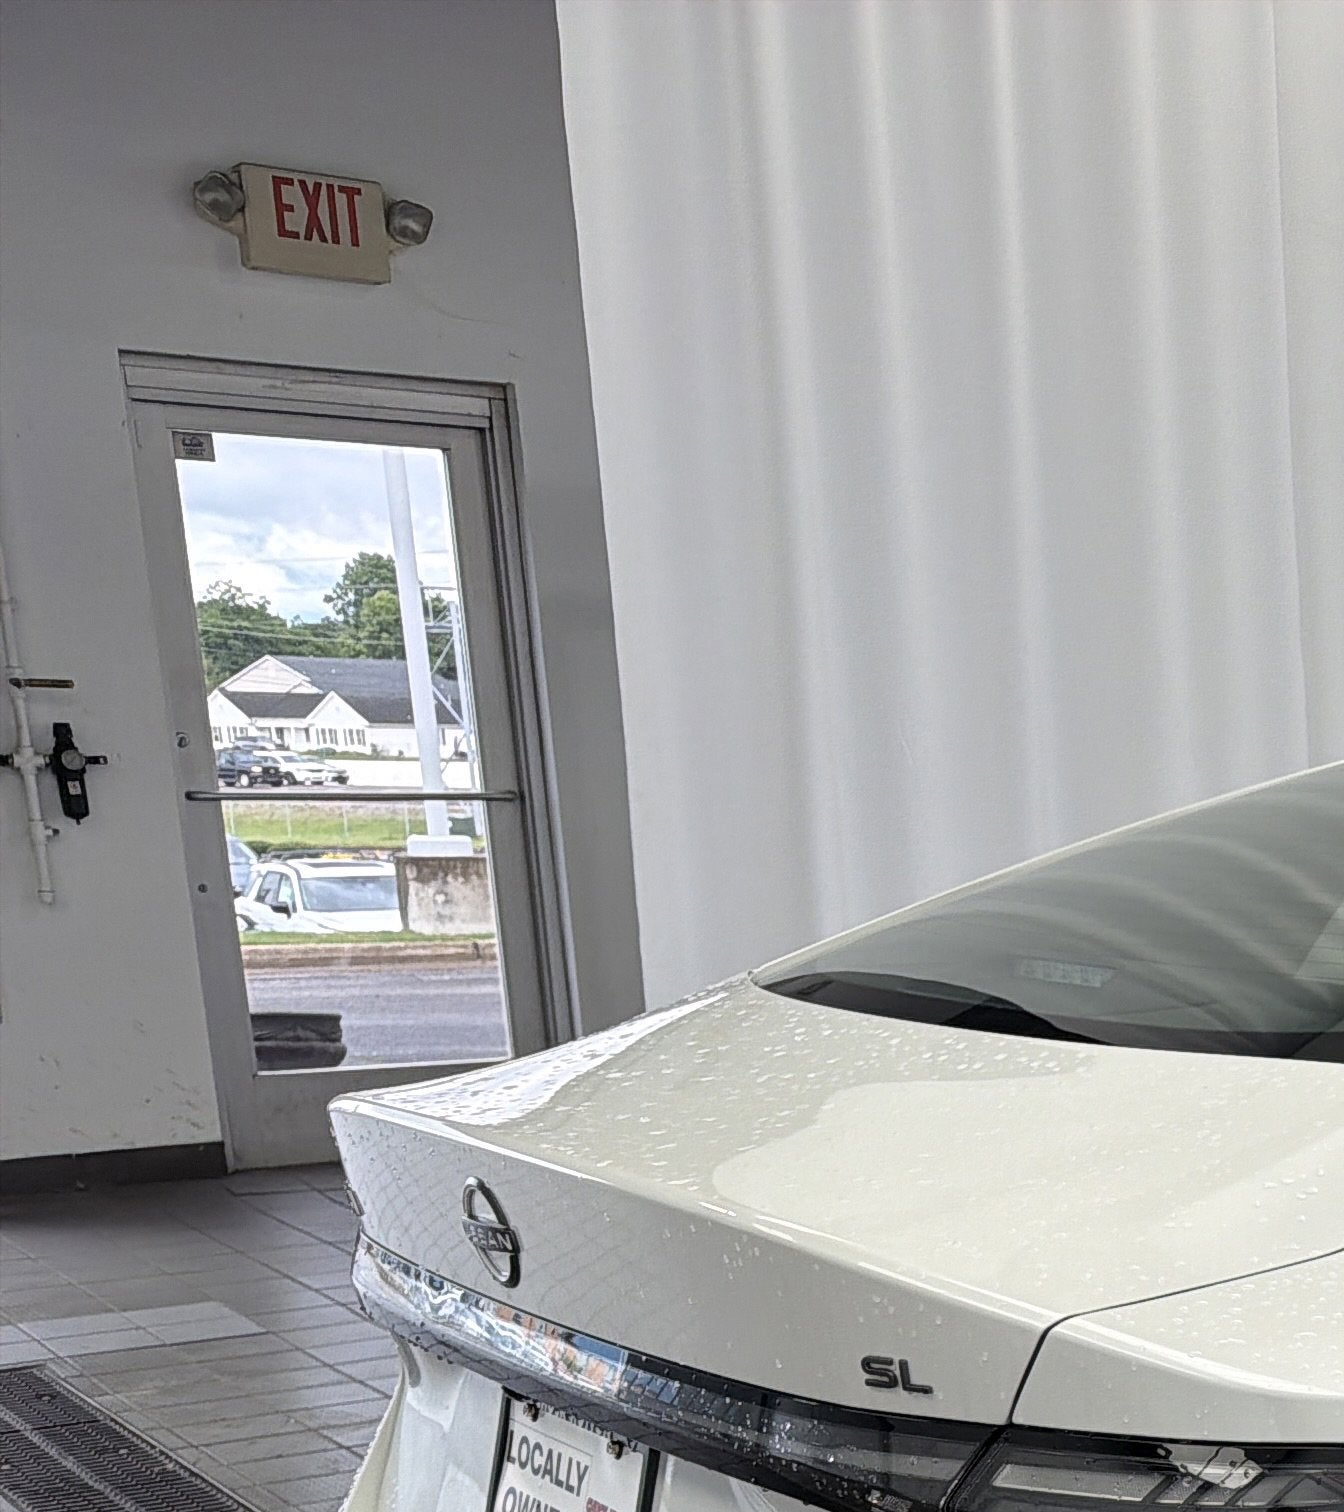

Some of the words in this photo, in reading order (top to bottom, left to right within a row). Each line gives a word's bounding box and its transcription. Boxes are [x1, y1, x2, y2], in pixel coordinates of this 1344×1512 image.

[271, 175, 362, 247] EXIT
[861, 1355, 934, 1394] SL
[507, 1429, 589, 1497] LOCALLY
